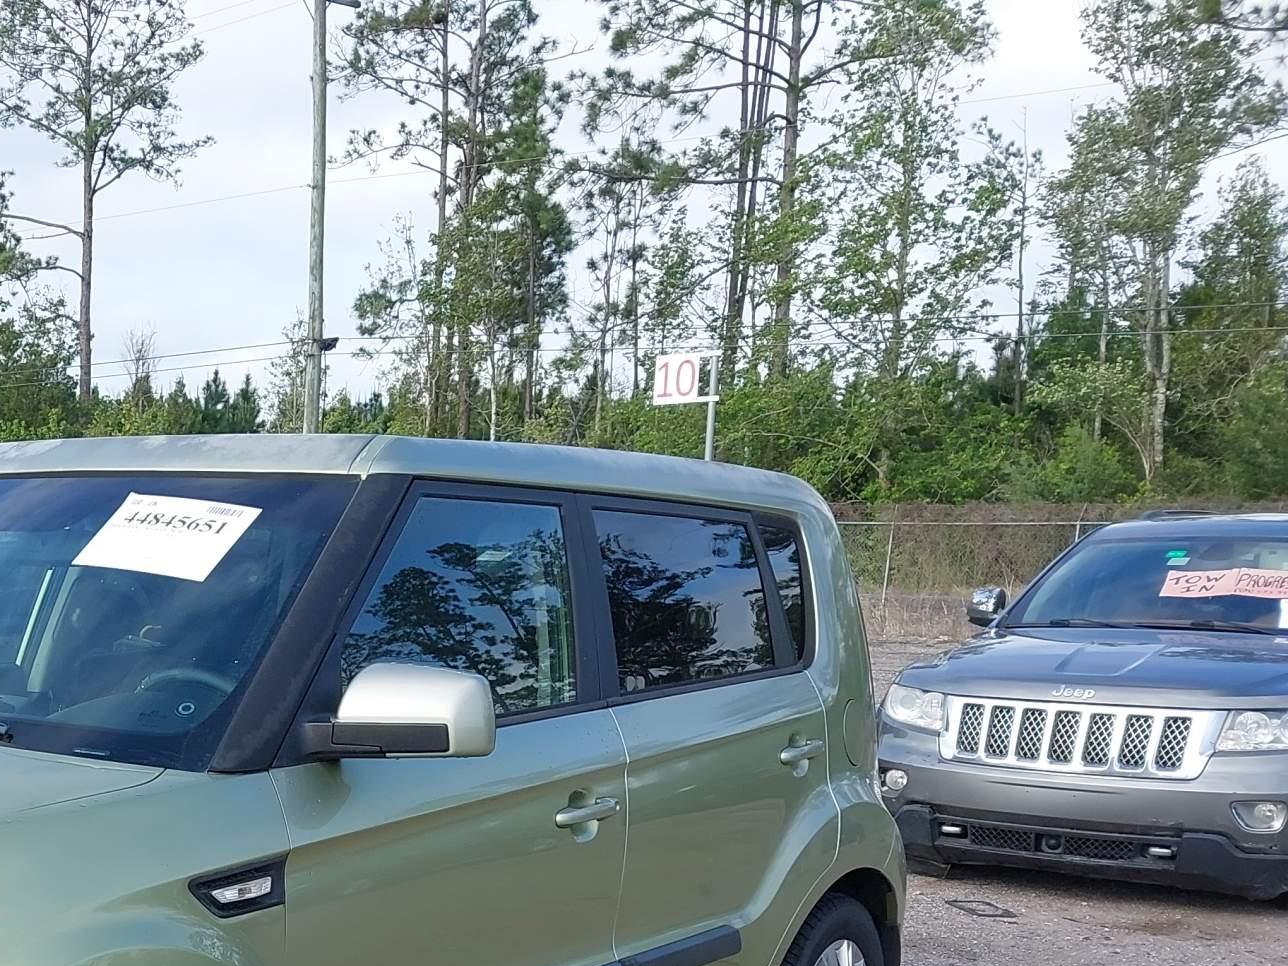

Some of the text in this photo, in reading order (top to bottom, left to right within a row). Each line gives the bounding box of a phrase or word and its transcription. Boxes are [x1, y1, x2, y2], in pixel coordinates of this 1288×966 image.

[657, 360, 696, 397] 10
[124, 511, 228, 534] 44845651
[1169, 574, 1226, 585] TOW
[1235, 573, 1288, 590] PROGRE
[1181, 584, 1215, 593] IN
[1051, 684, 1096, 700] Jeep
